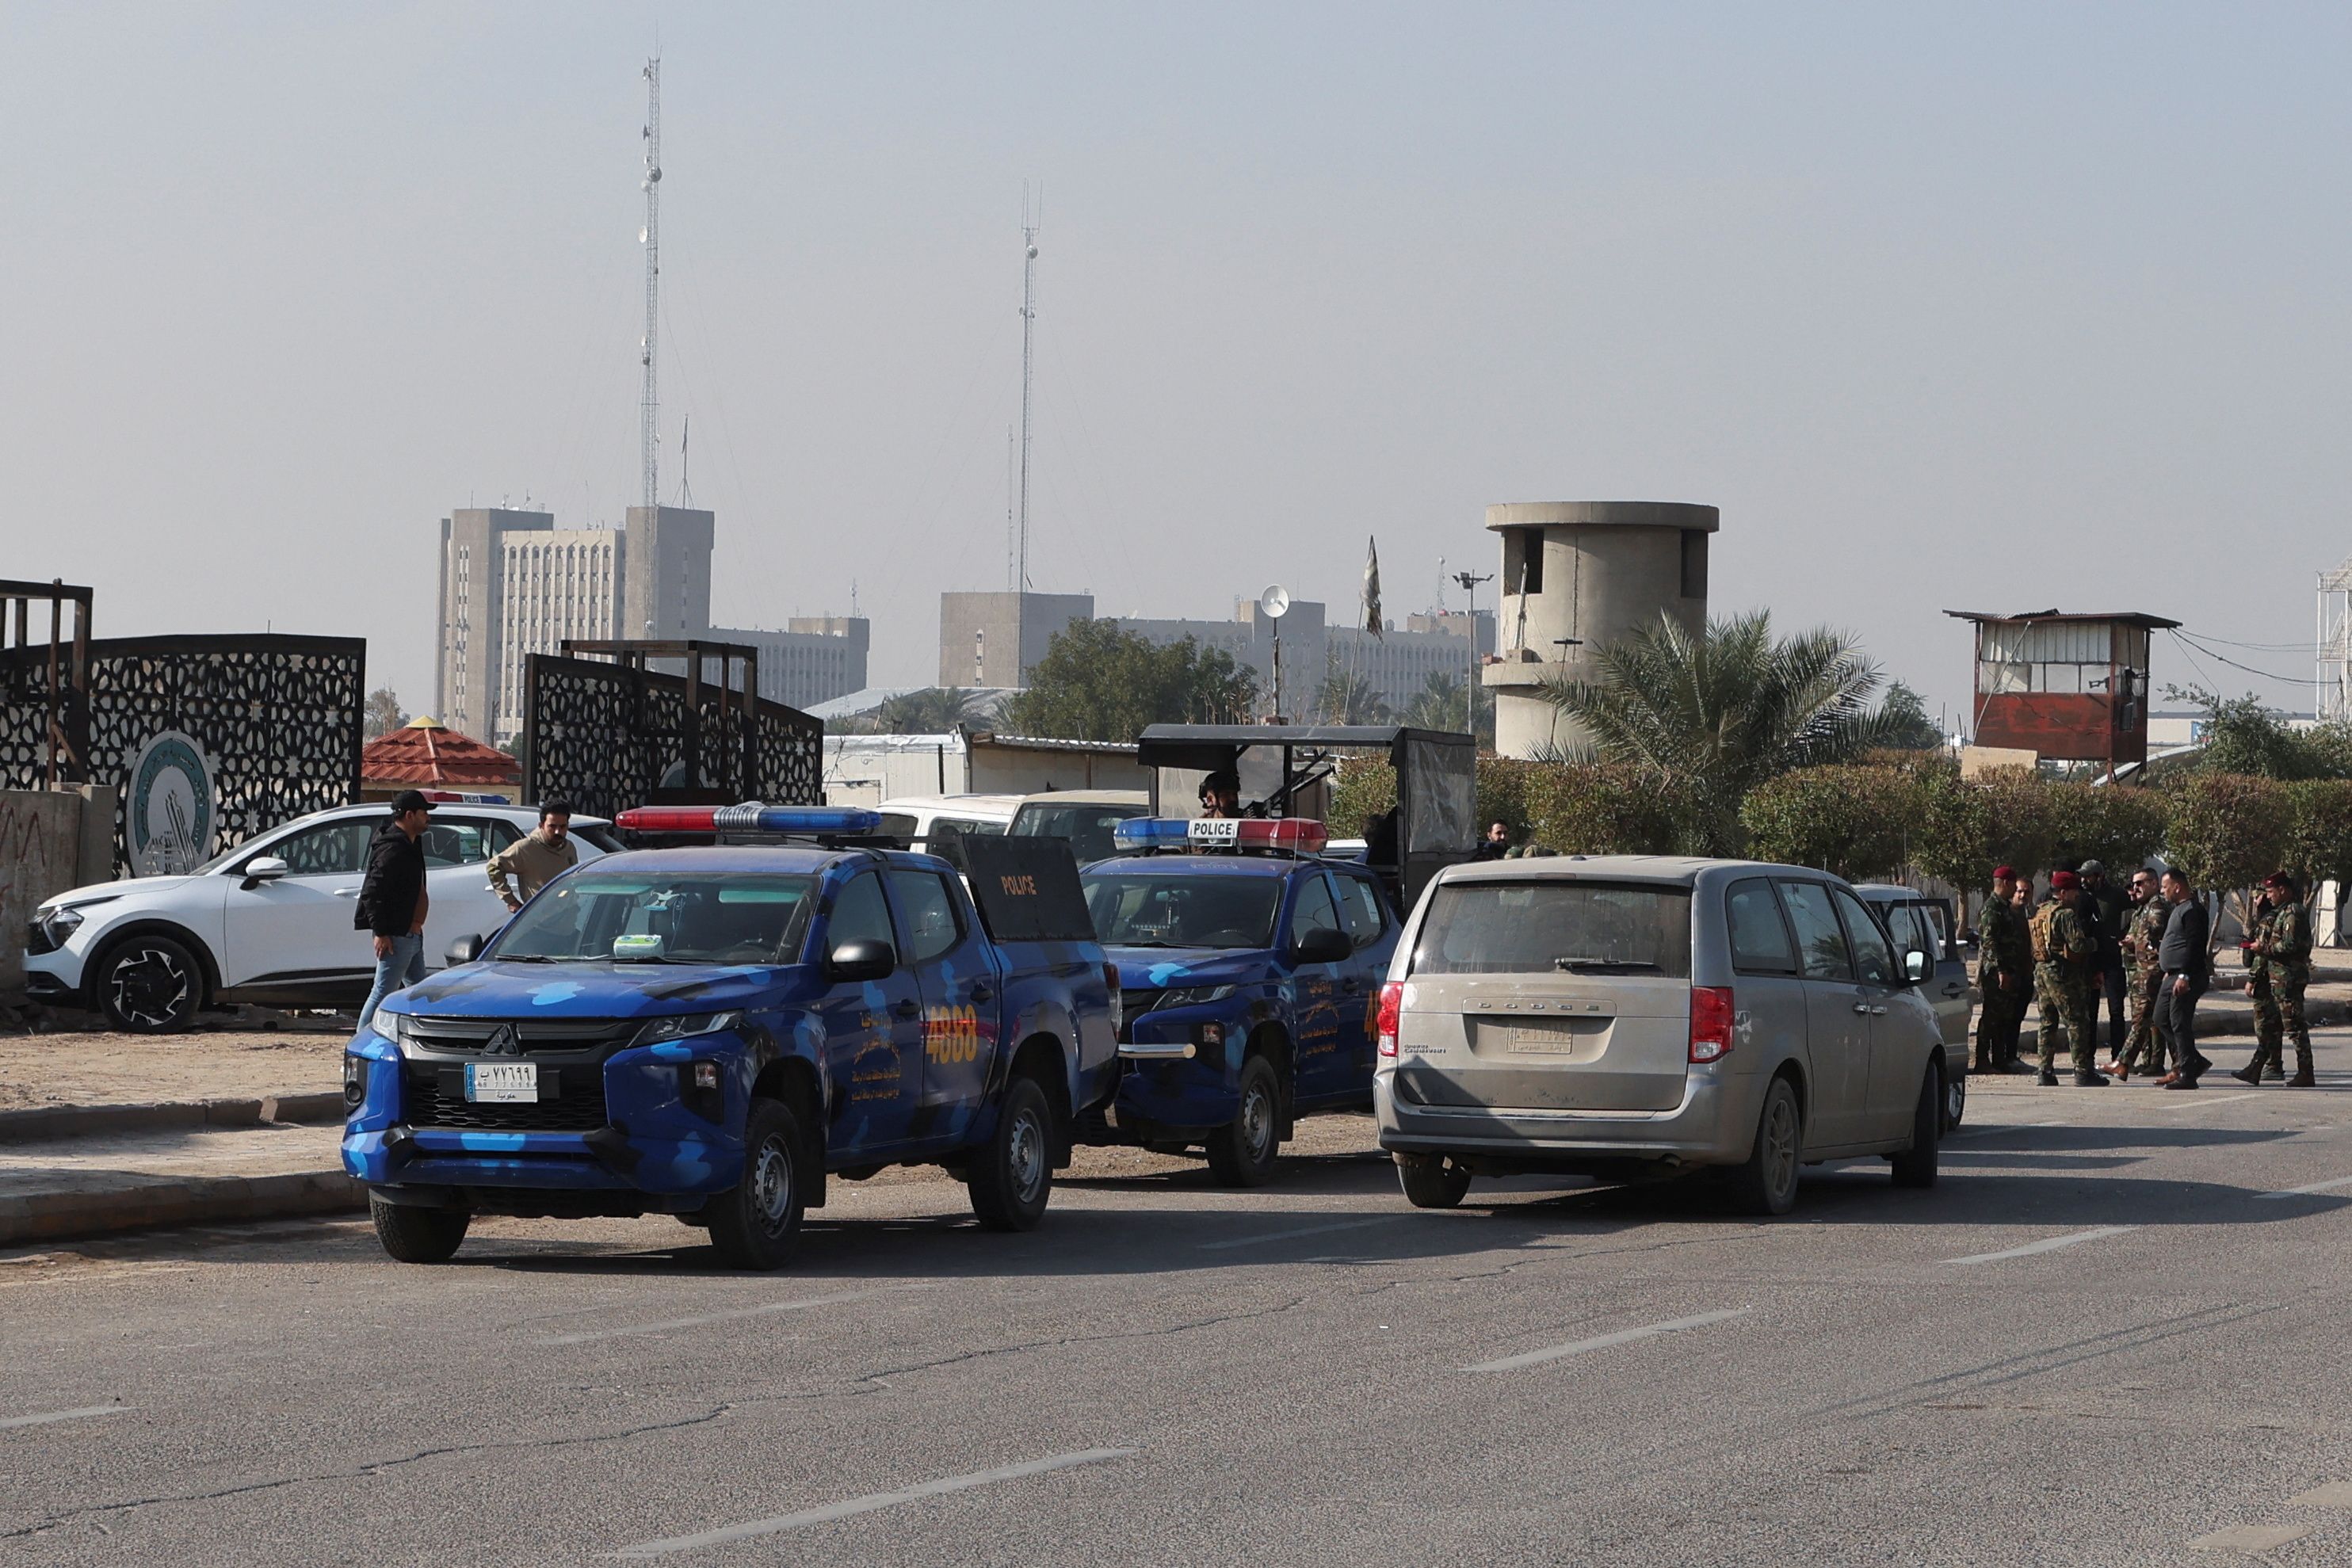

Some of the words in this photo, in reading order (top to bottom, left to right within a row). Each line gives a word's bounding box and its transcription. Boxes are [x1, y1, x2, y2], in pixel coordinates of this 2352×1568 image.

[1194, 823, 1231, 835] POLICE
[1001, 876, 1037, 895] POLICE
[926, 1004, 977, 1064] 4888
